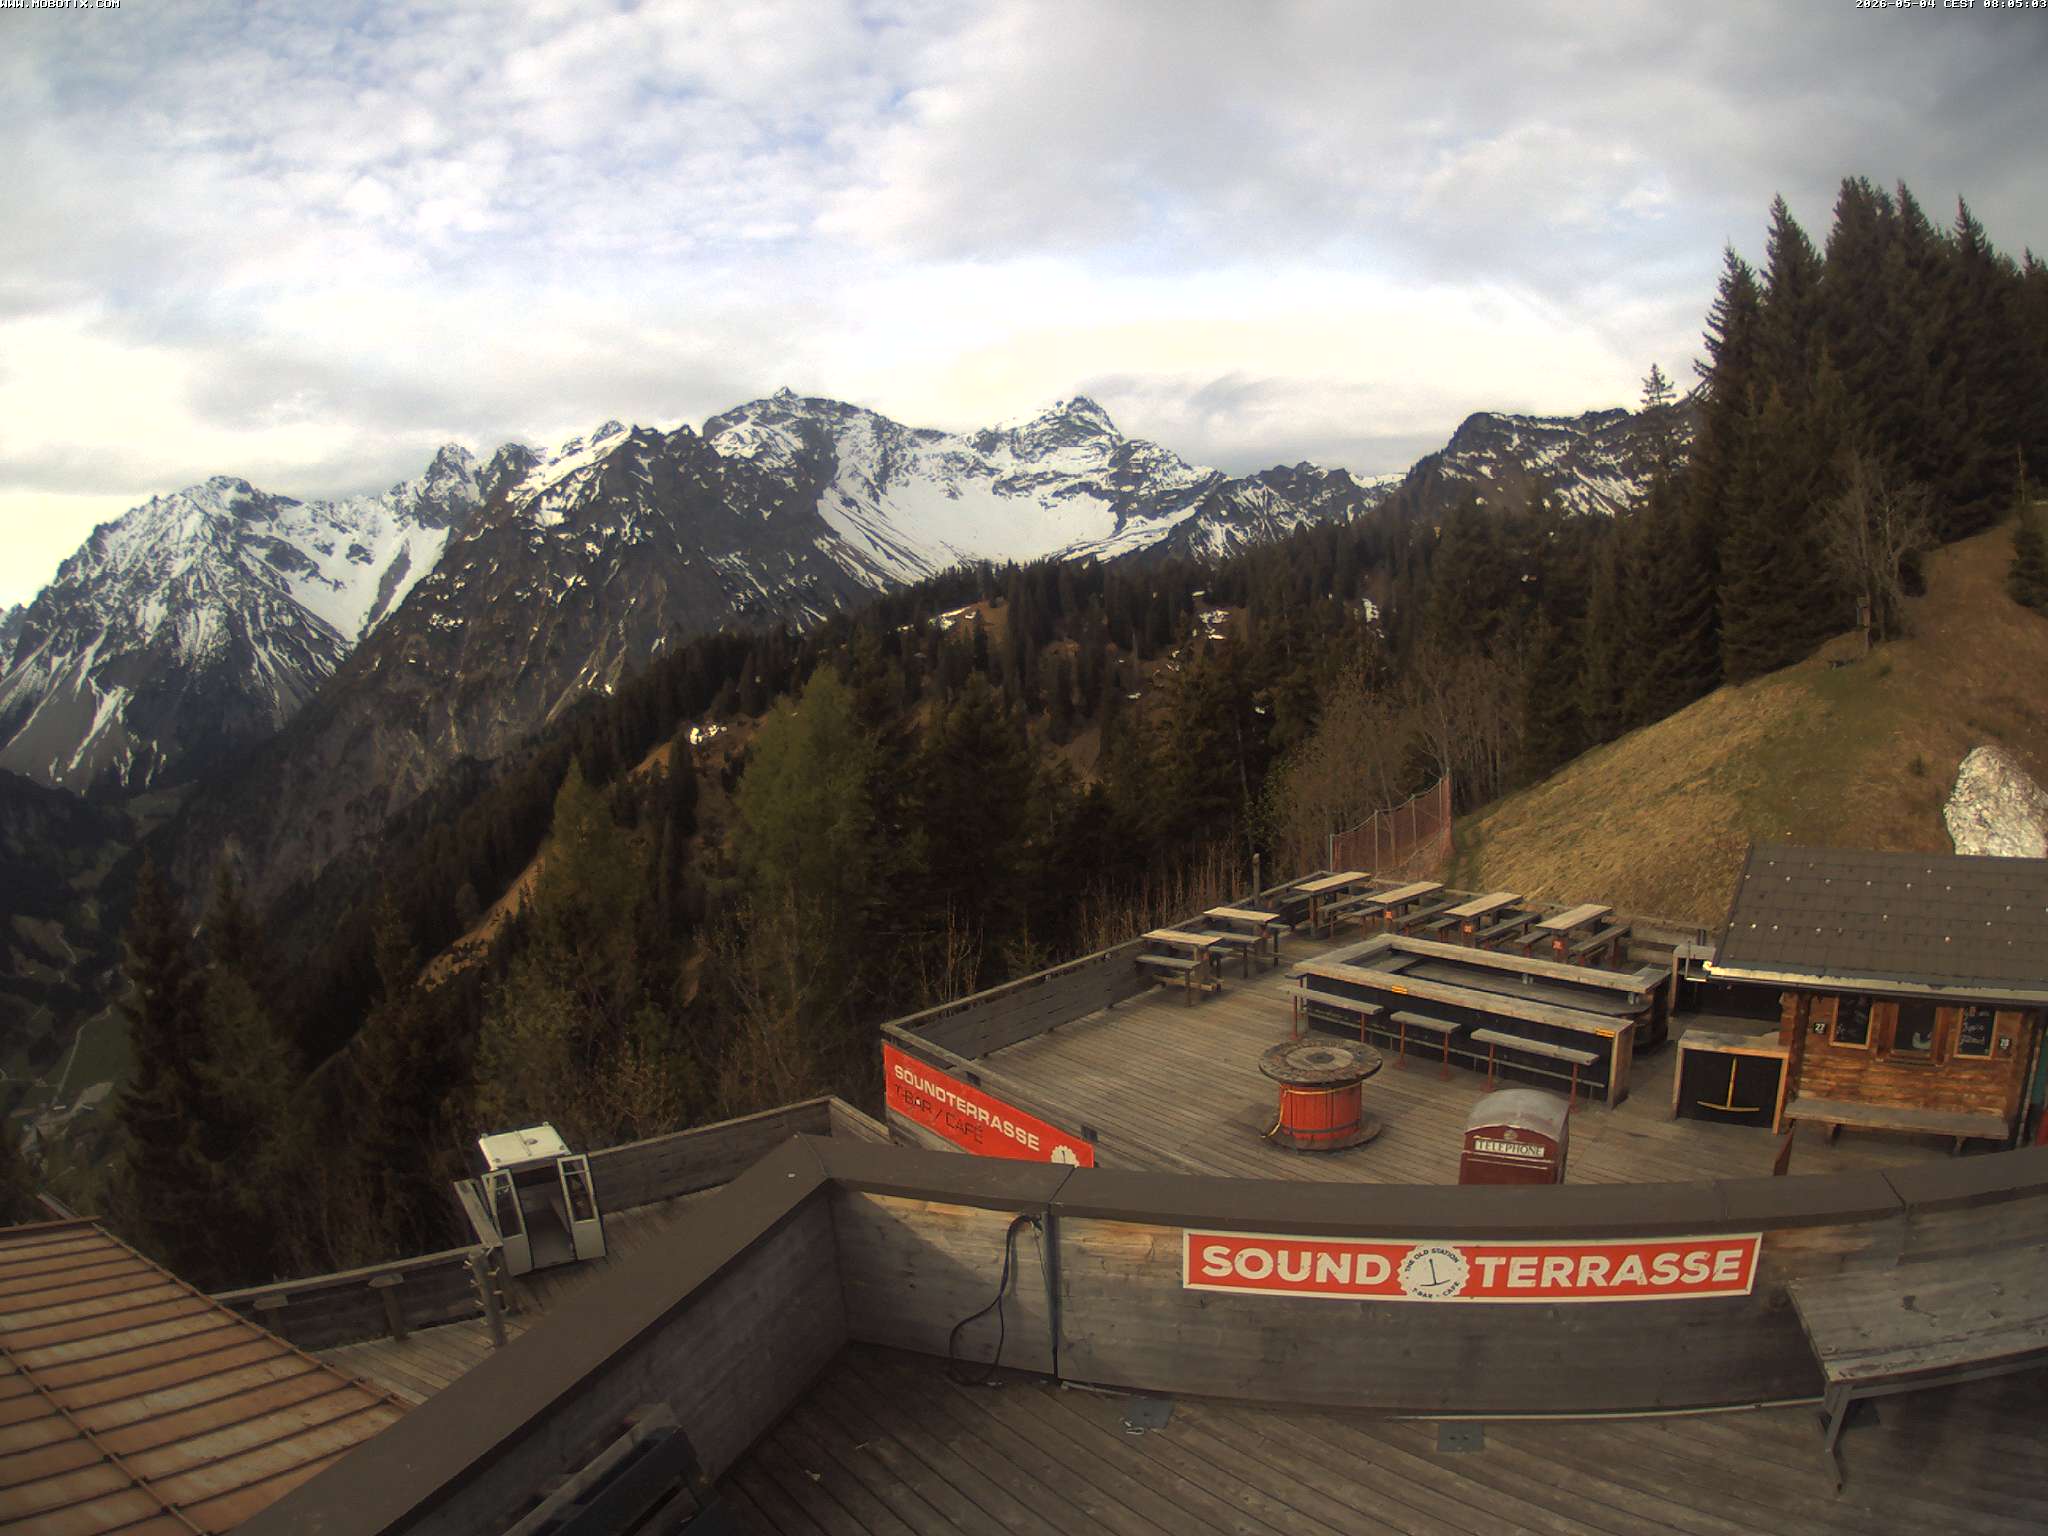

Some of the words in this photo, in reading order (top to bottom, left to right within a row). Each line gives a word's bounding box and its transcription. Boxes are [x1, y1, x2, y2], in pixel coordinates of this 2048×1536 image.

[895, 1064, 1040, 1151] SOUNDTERRASSE
[1478, 1140, 1543, 1156] TELEPHONE
[1202, 1245, 1391, 1286] SOUND
[1475, 1249, 1744, 1288] TERRASSE
[1404, 1259, 1415, 1272] THE
[1413, 1249, 1429, 1260] OLD
[1431, 1247, 1460, 1264] STATION
